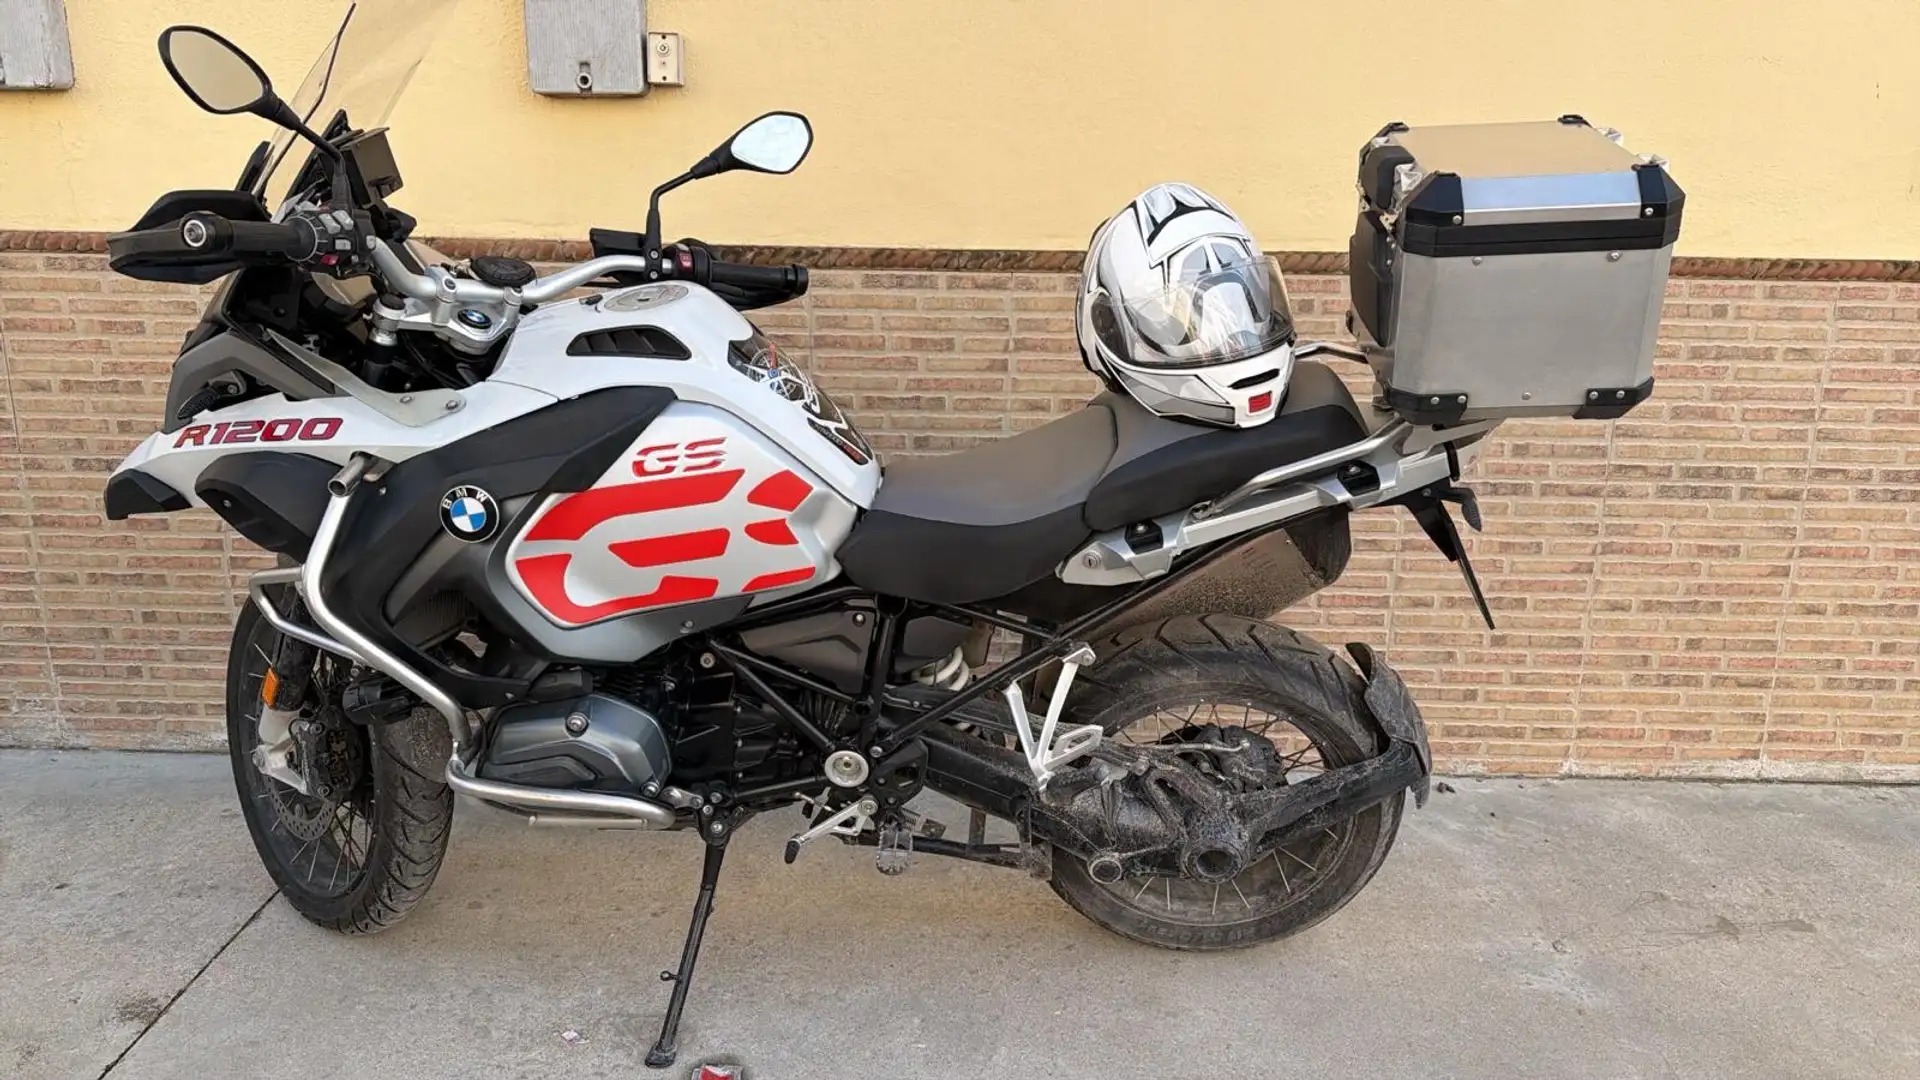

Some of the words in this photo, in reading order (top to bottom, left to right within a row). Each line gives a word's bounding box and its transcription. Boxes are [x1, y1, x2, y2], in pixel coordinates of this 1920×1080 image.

[172, 417, 344, 448] R1200
[632, 436, 727, 477] GS
[441, 487, 489, 509] BMW
